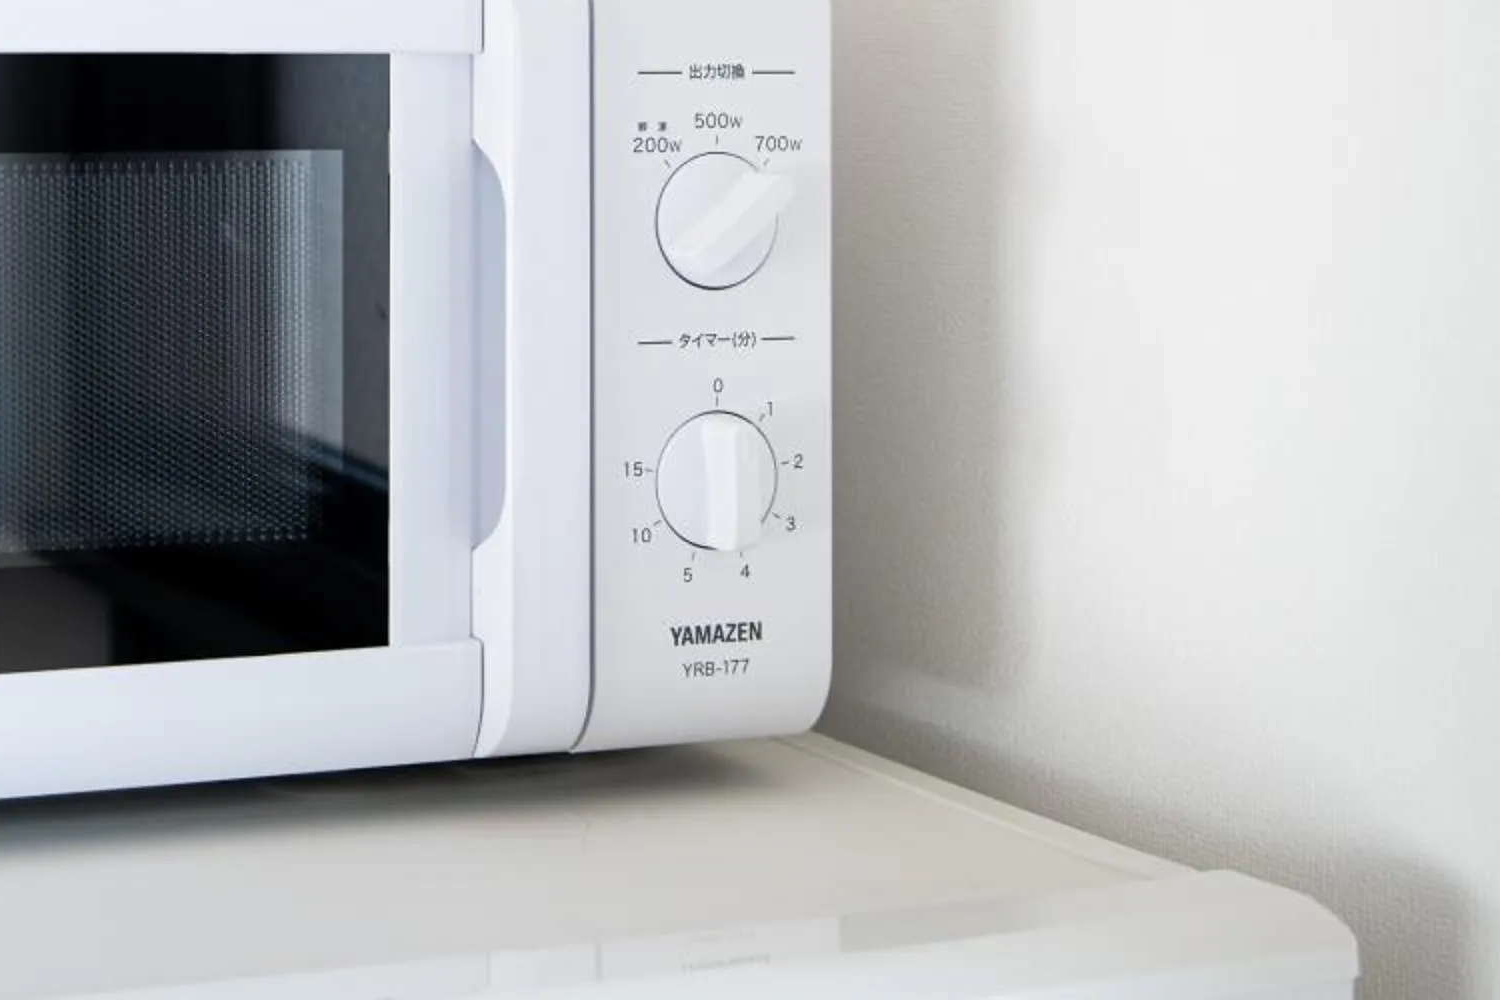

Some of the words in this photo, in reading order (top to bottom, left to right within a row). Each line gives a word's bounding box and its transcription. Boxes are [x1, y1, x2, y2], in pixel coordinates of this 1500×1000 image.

[689, 63, 745, 80] 出力切換
[712, 377, 725, 394] 0
[765, 402, 773, 417] 1
[624, 461, 643, 478] 15
[793, 453, 804, 470] 2
[786, 516, 797, 532] 3
[632, 527, 653, 544] 10
[683, 567, 693, 583] 5
[740, 563, 751, 579] 4
[670, 621, 763, 647] YAMAZEN
[681, 657, 750, 678] YRB-177
